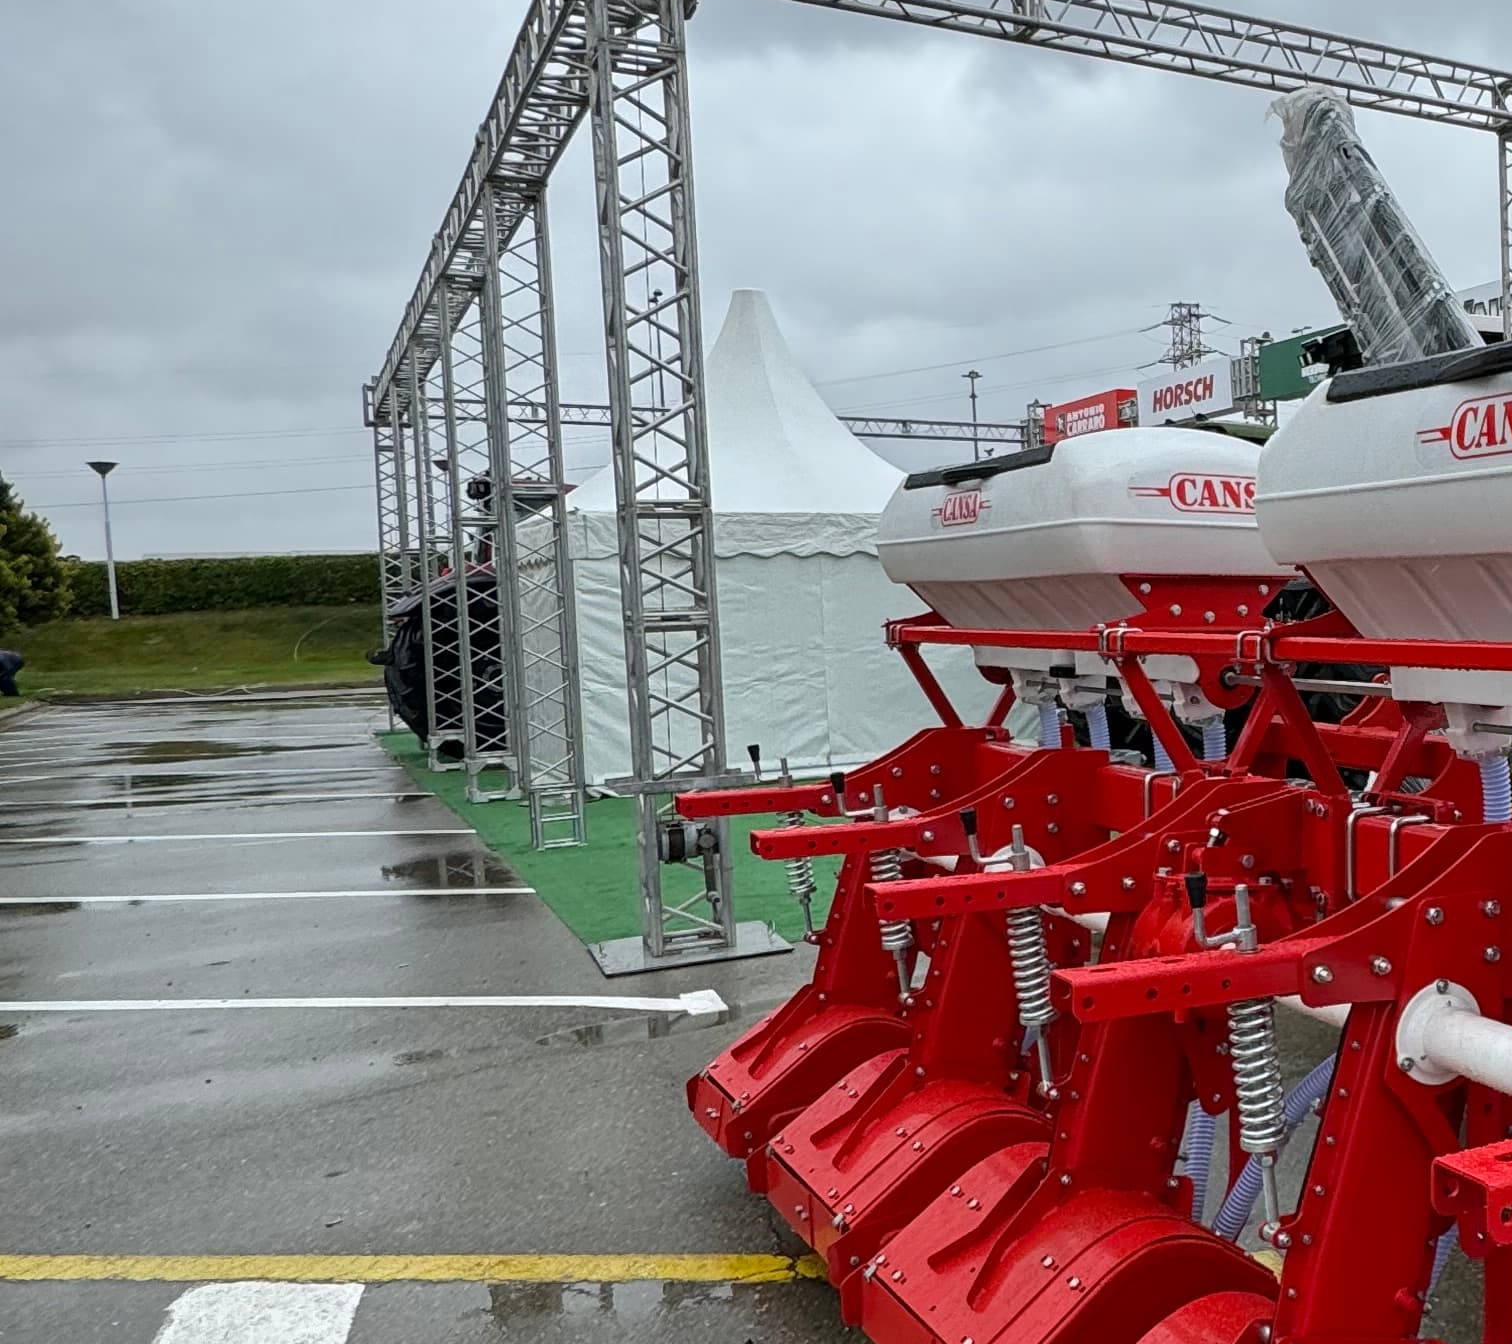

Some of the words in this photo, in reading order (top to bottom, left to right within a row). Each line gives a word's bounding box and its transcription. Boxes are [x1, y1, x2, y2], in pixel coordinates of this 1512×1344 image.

[1153, 374, 1214, 413] HORSCH
[1066, 414, 1106, 437] CARRARO
[1176, 478, 1256, 509] CANS
